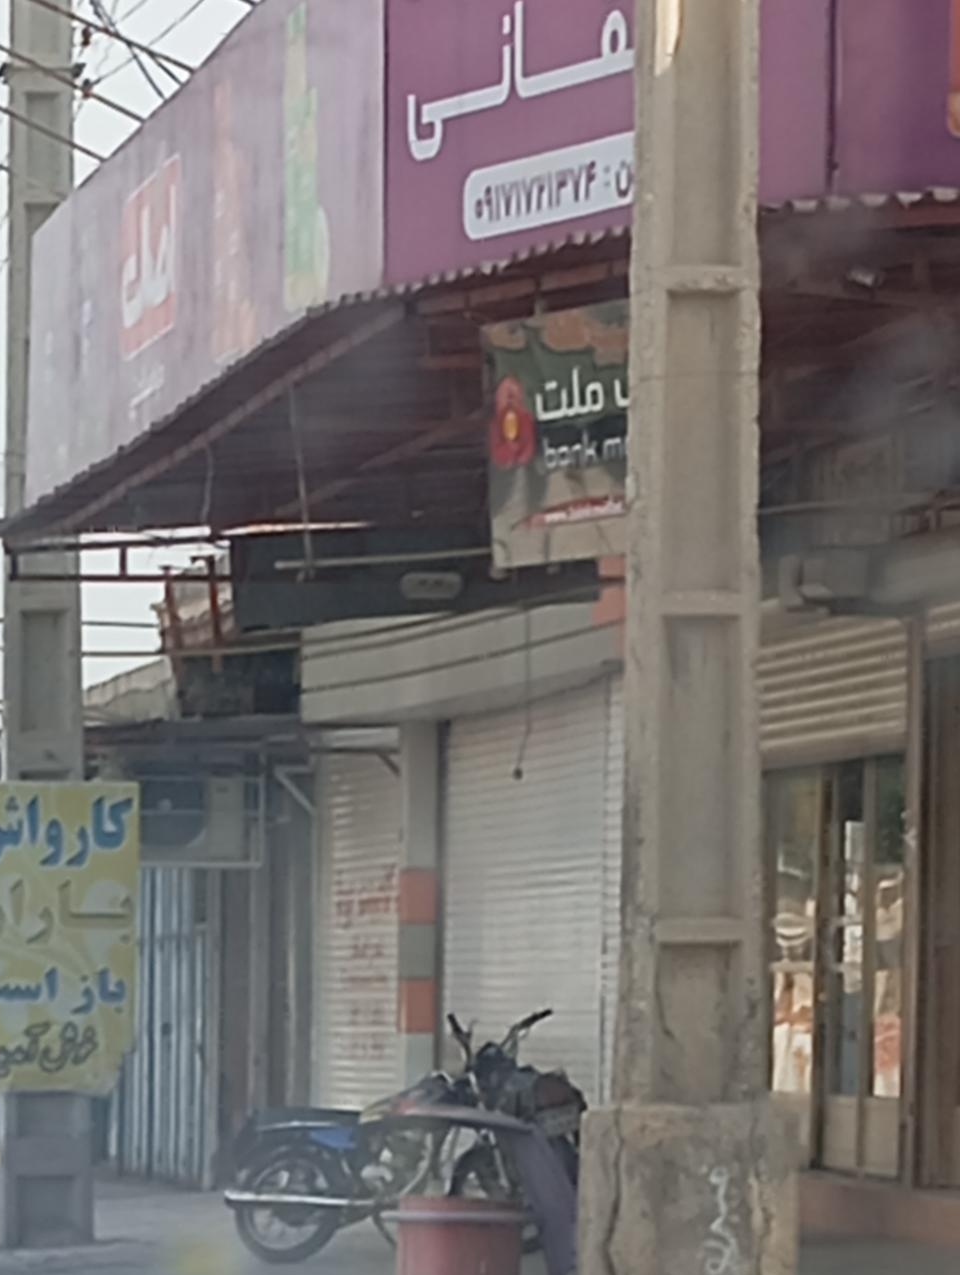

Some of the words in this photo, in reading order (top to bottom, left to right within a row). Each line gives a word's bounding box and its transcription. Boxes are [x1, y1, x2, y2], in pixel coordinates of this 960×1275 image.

[535, 365, 605, 421] ملت
[543, 431, 597, 468] bank
[71, 966, 126, 1014] باز
